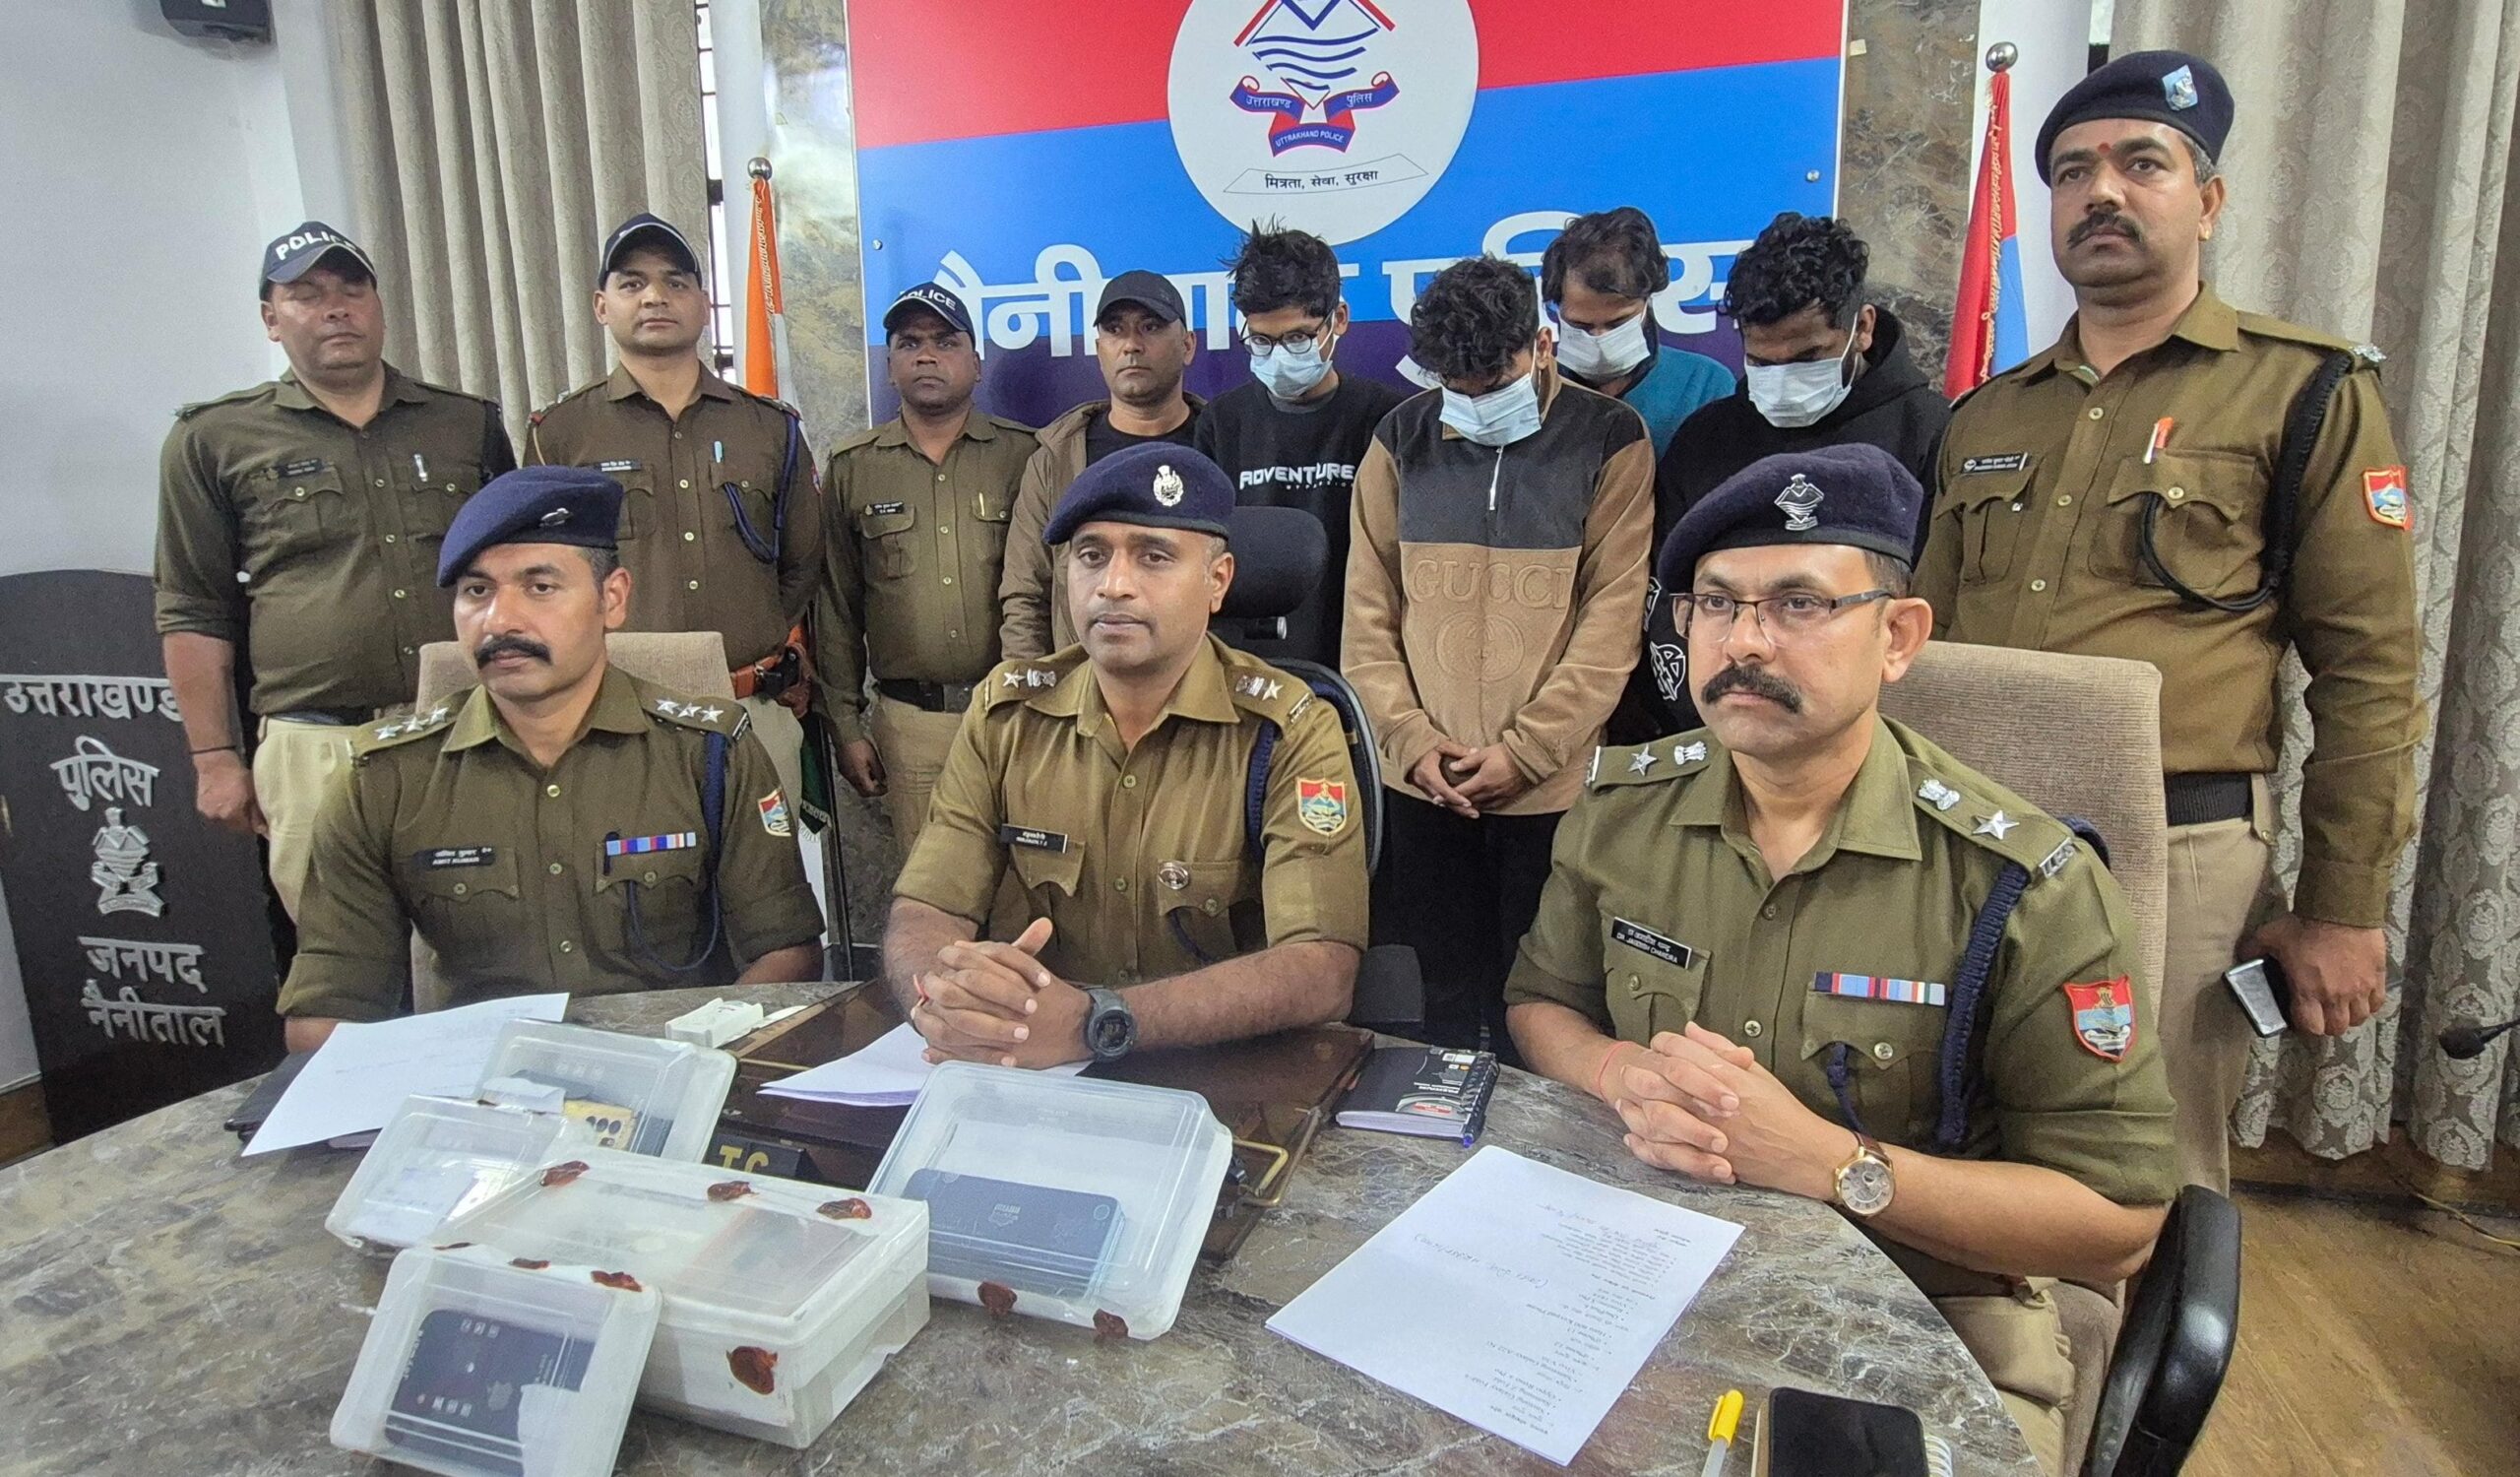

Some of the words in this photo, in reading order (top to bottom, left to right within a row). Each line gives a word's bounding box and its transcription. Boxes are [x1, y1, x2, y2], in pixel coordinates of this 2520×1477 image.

[1347, 93, 1373, 107] पुलिस
[1320, 129, 1345, 143] POLICE
[1265, 173, 1305, 189] मित्रता,
[1310, 175, 1339, 187] सेवा,
[1345, 170, 1379, 184] सुरक्षा
[1239, 462, 1355, 490] ADVENTURE
[1409, 559, 1572, 609] GUCCI
[50, 736, 159, 810] पुलिस
[79, 935, 208, 994] जनपद
[82, 978, 227, 1047] नैनीताल
